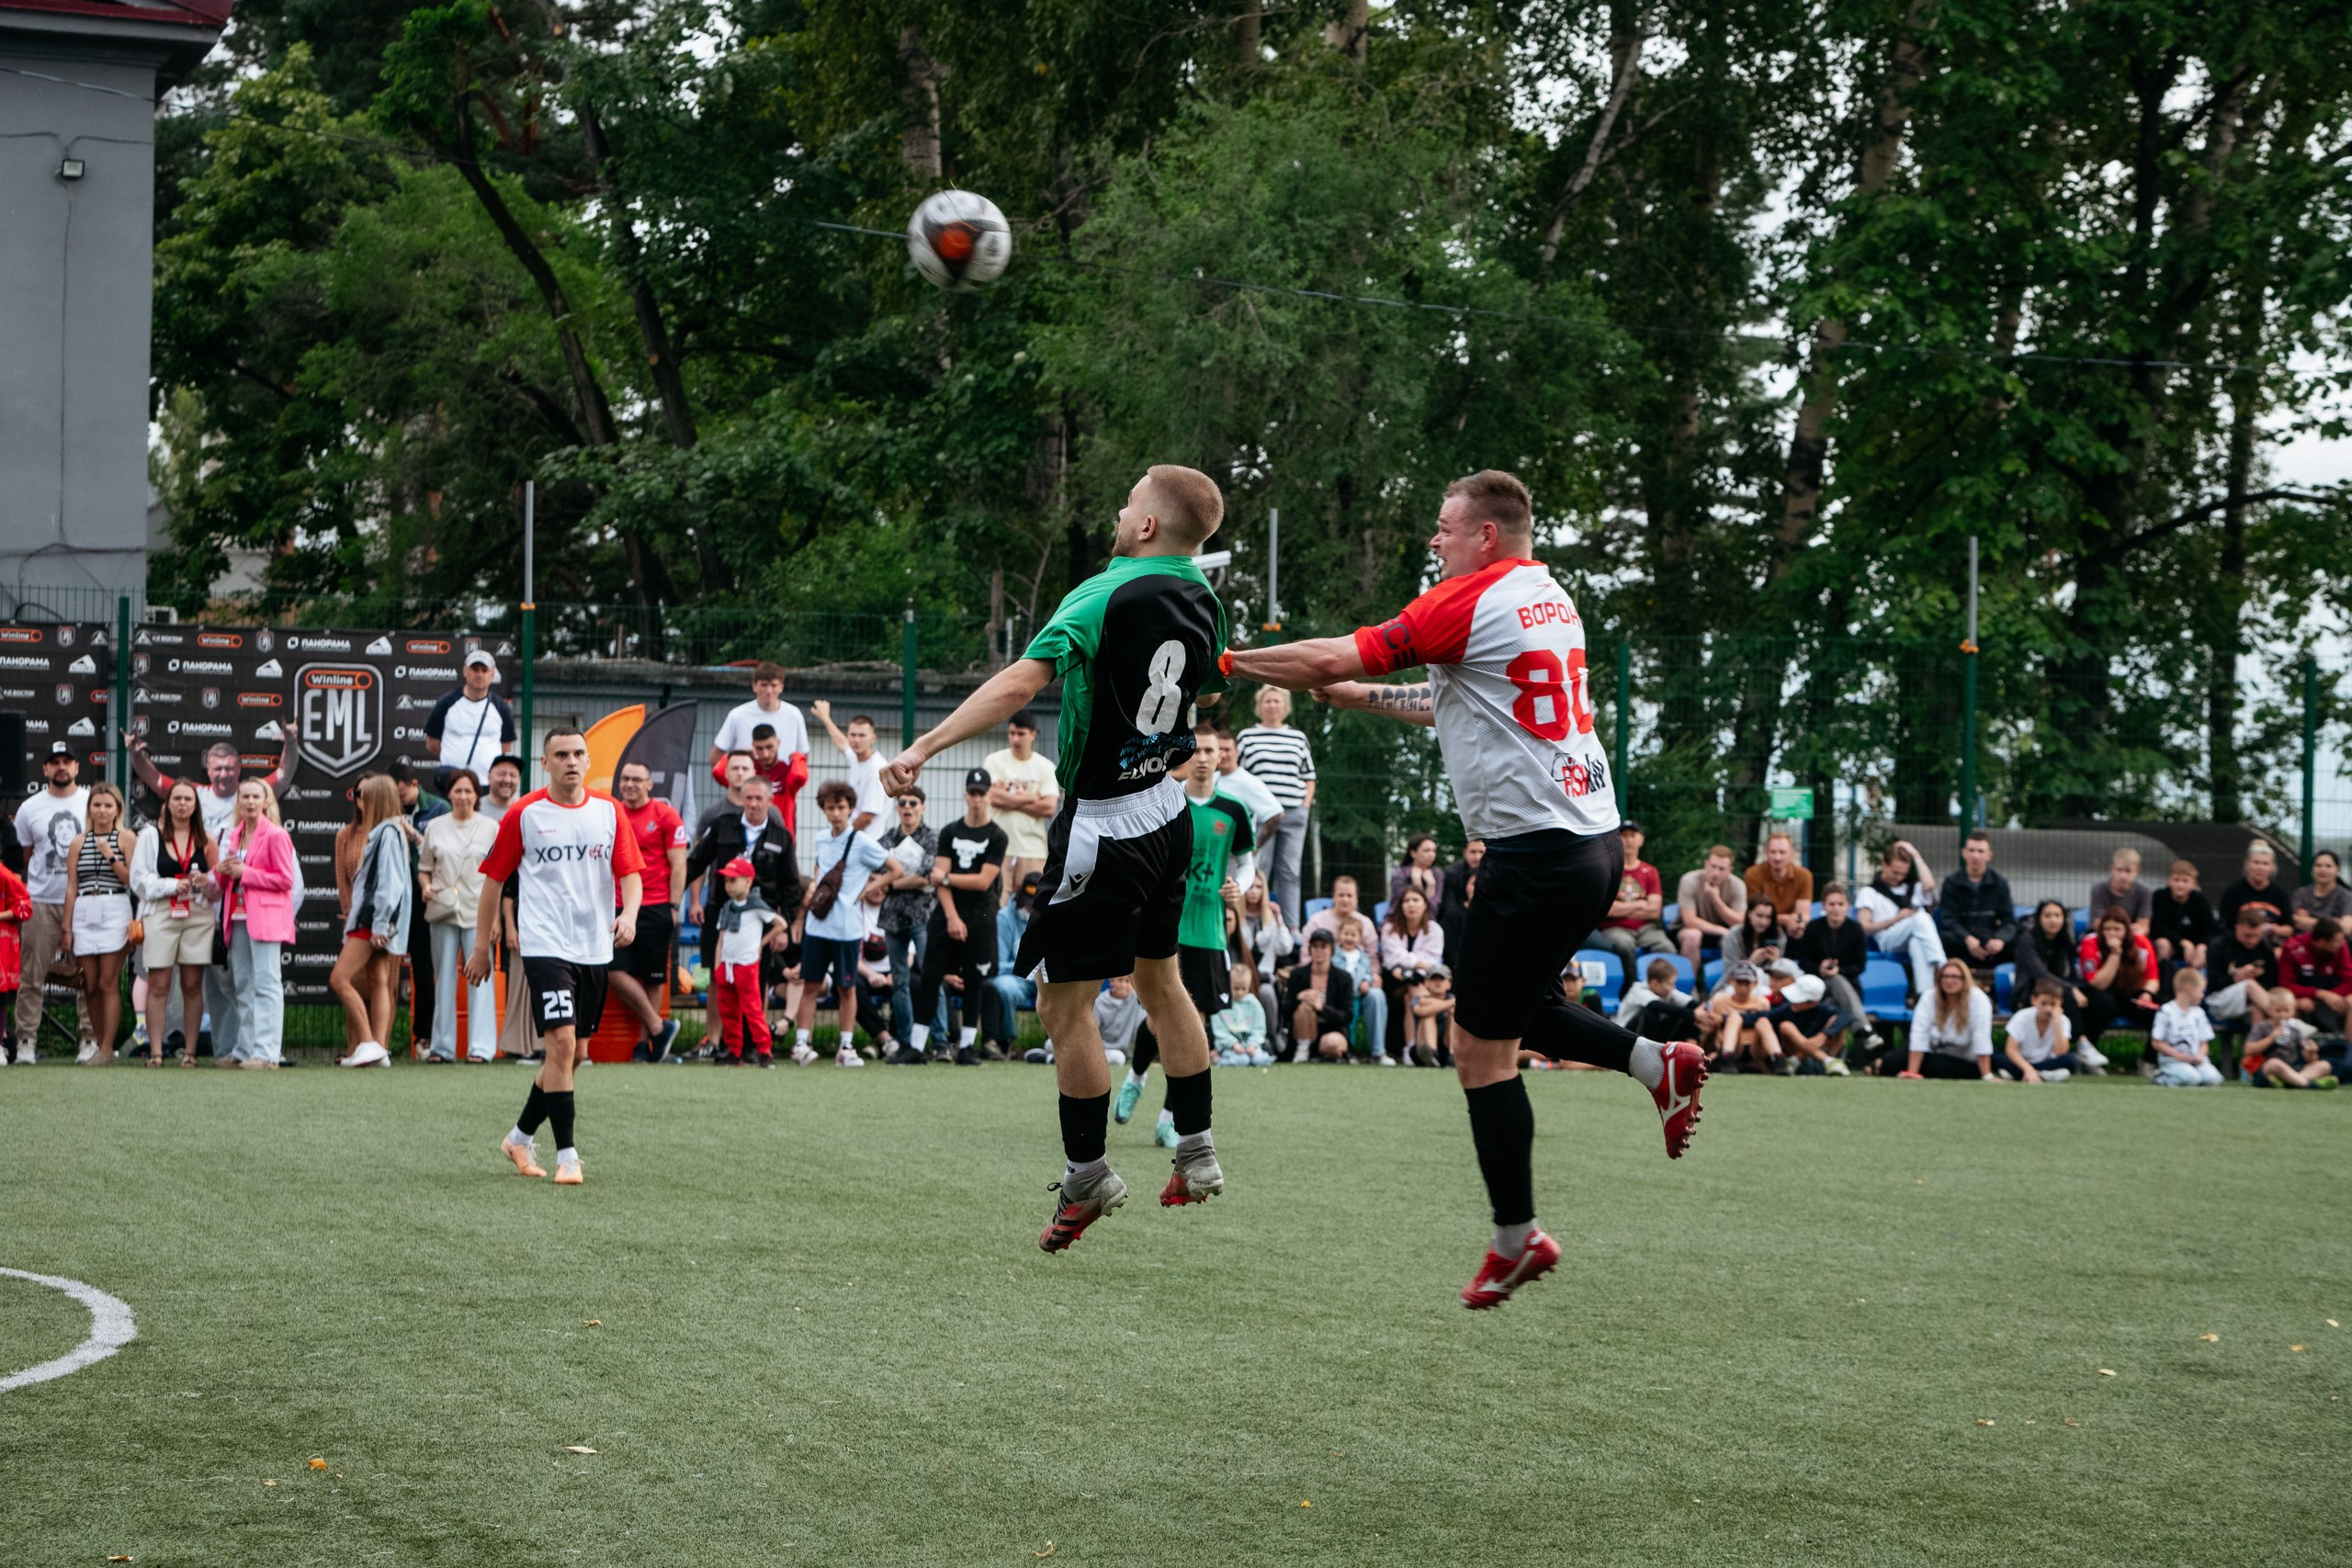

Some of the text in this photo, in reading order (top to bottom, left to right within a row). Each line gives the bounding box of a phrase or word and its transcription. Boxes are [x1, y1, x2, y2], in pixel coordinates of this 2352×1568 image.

[301, 638, 351, 649] ПАНОРАМА
[183, 660, 232, 671] ПАНОРАМА
[409, 667, 458, 677] ПАНОРАМА
[311, 674, 354, 685] Winline
[1136, 639, 1186, 737] 8
[302, 689, 372, 742] EML
[182, 722, 232, 733] ПАНОРАМА
[304, 887, 339, 897] АНОРАМ
[295, 953, 337, 964] ПАНОРАМ
[542, 989, 574, 1021] 25
